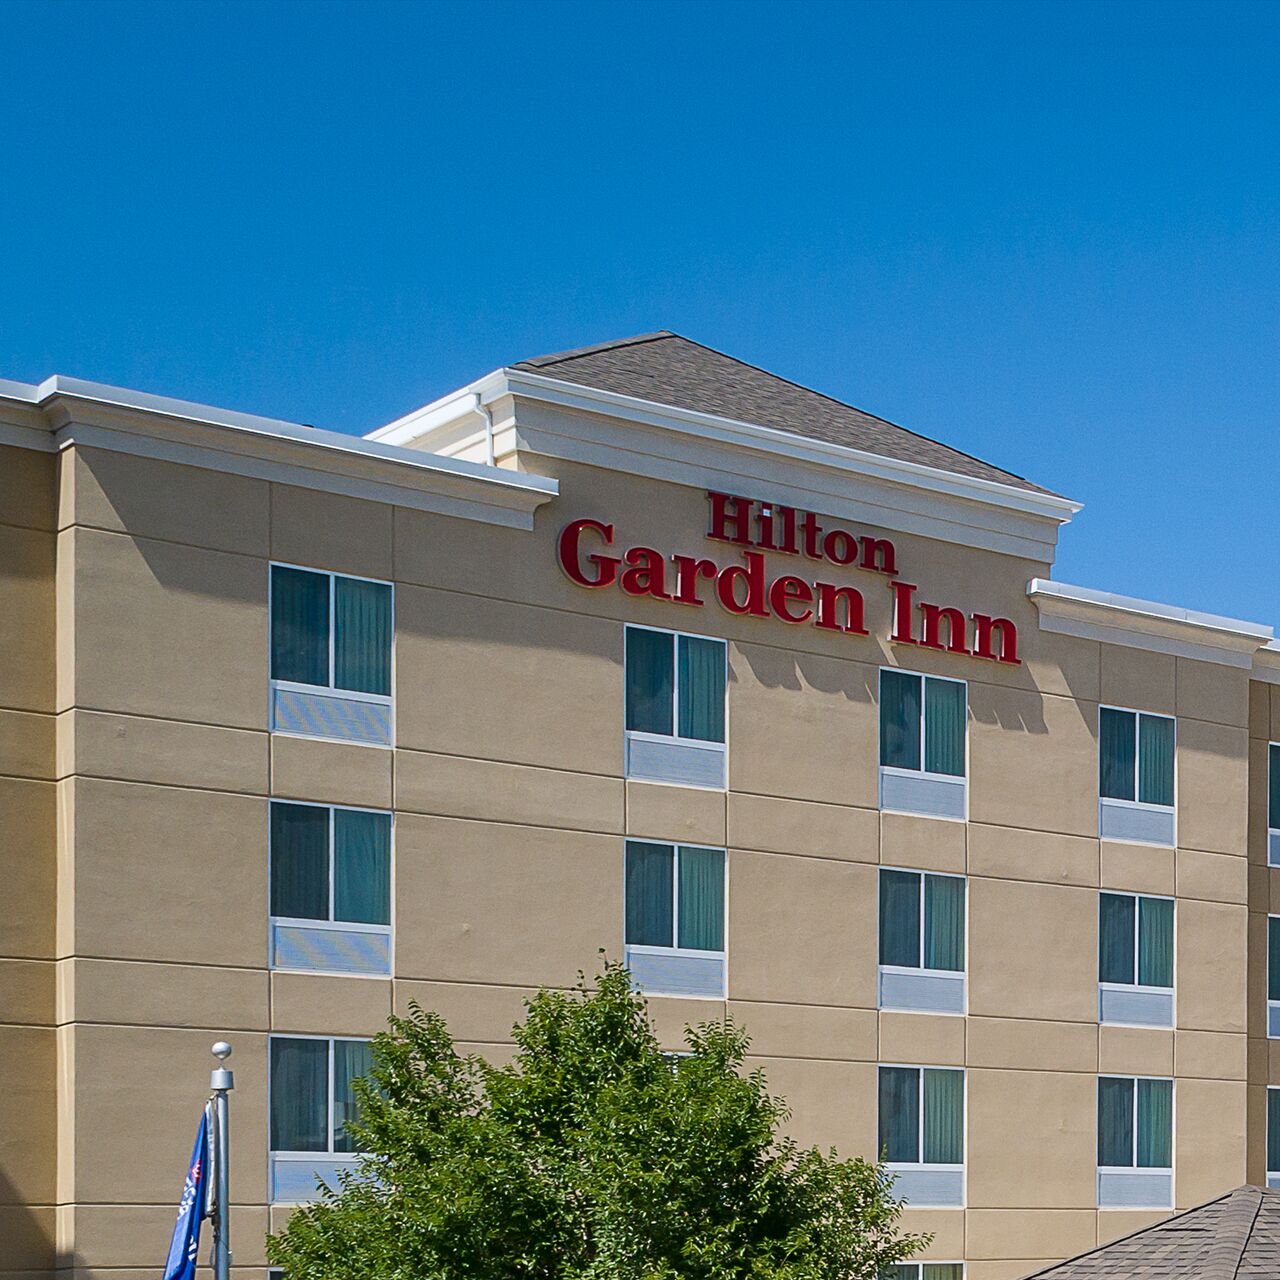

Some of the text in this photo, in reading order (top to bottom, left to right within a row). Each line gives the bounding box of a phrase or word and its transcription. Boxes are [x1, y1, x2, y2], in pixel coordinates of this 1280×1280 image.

[706, 490, 899, 575] Hilton
[557, 517, 1022, 665] Garden Inn
